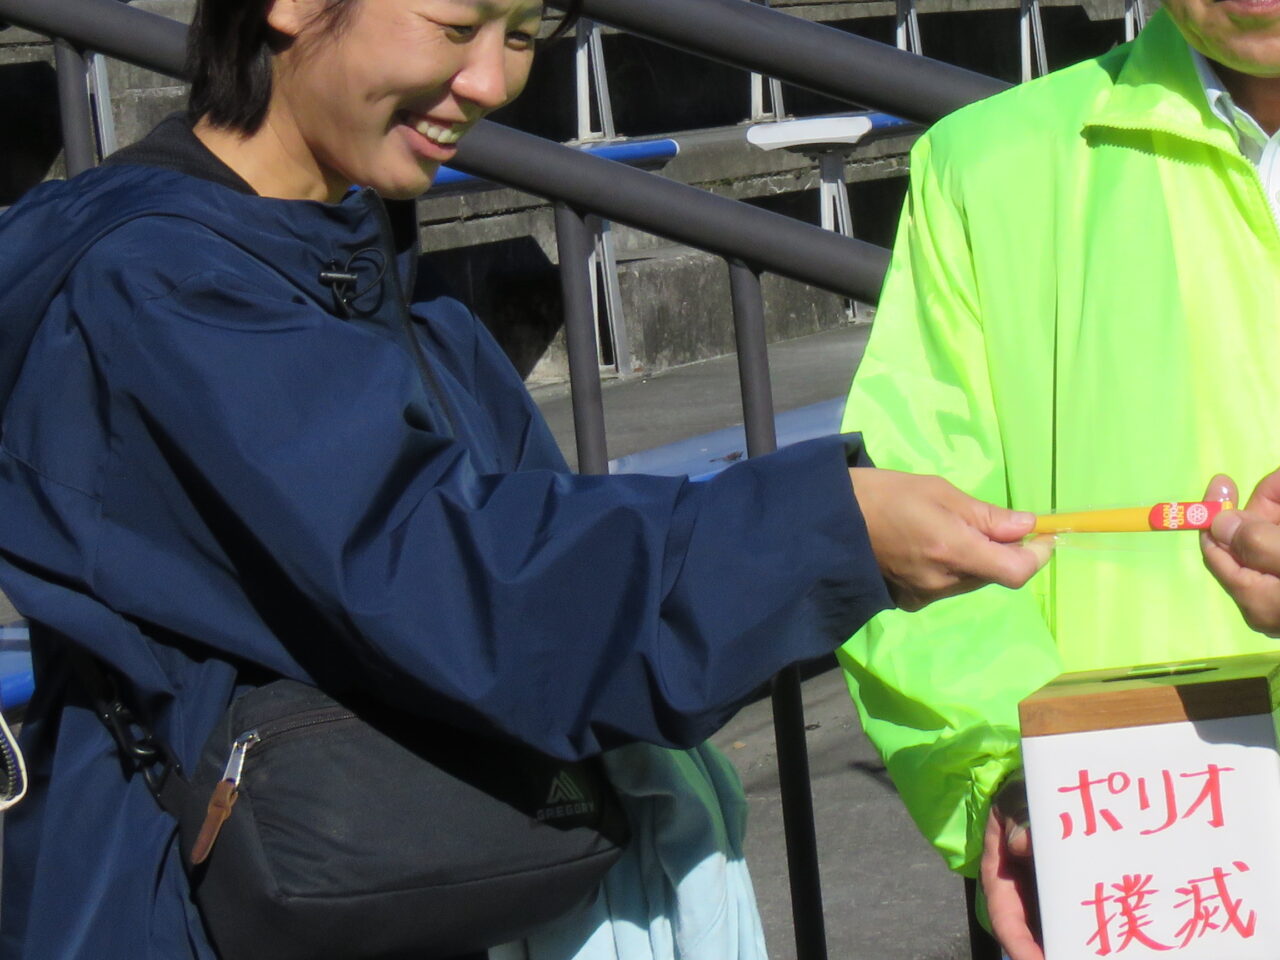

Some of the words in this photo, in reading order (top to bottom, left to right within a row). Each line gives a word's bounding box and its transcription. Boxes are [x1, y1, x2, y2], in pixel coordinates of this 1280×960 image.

[1162, 504, 1170, 528] NOW
[1169, 502, 1178, 529] POLIO
[1176, 505, 1185, 526] END
[1057, 763, 1236, 840] ポリオ
[1081, 861, 1258, 957] 撲滅
